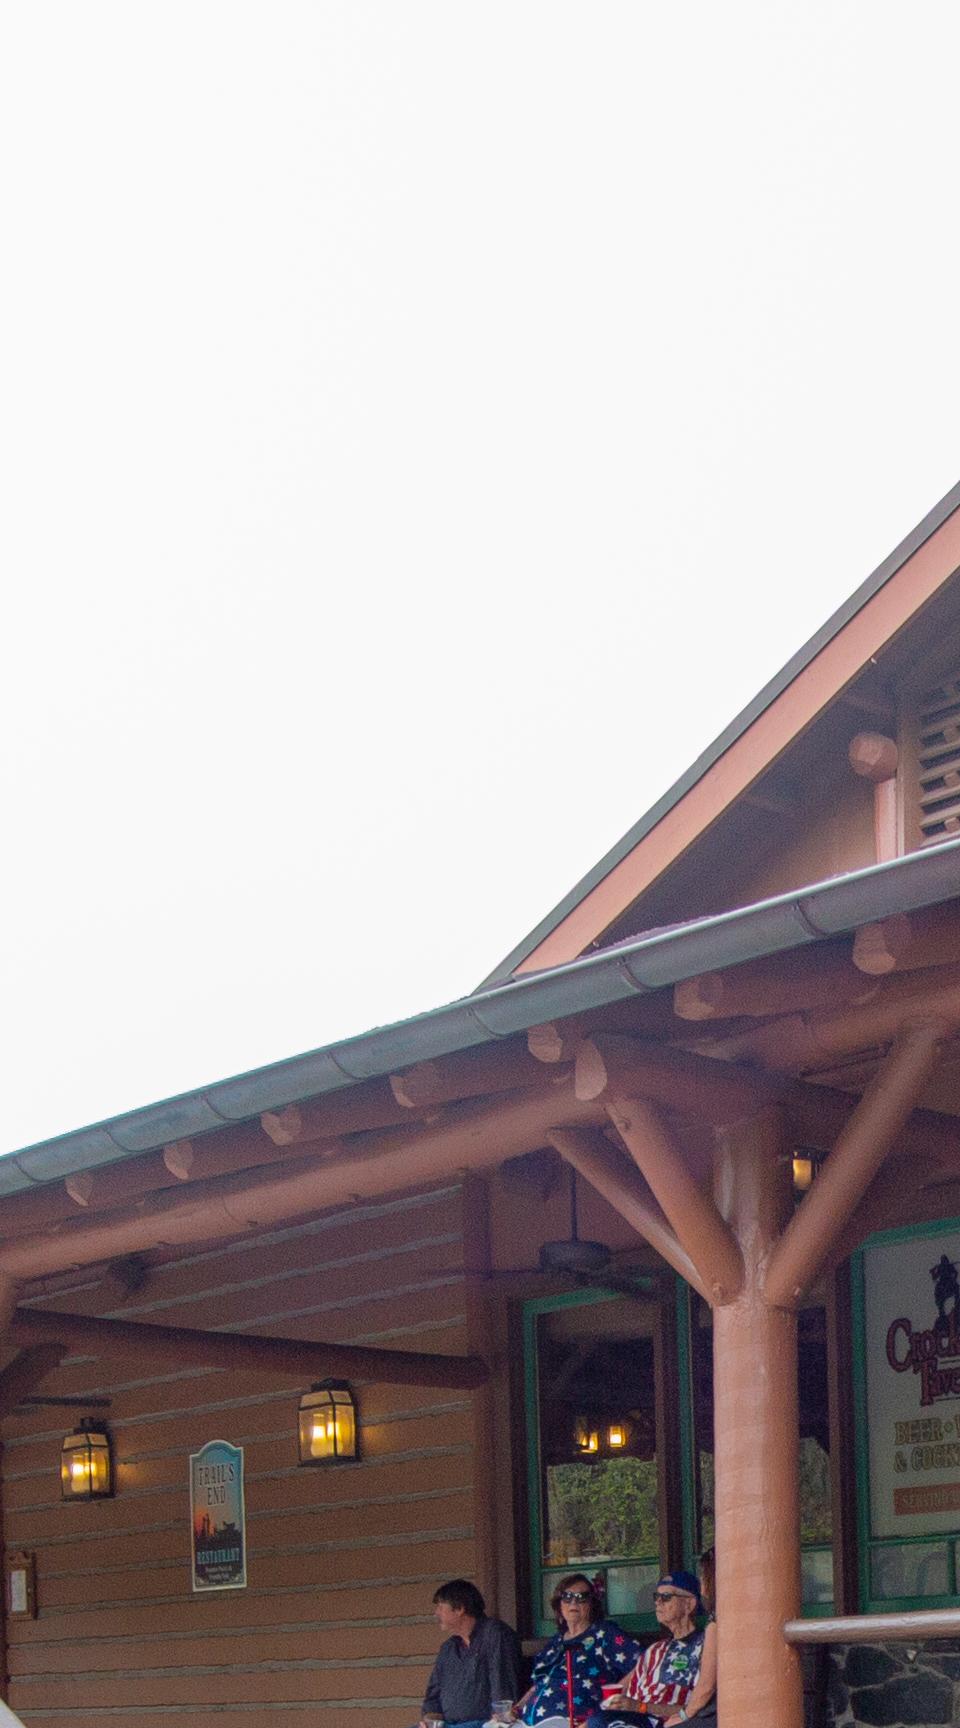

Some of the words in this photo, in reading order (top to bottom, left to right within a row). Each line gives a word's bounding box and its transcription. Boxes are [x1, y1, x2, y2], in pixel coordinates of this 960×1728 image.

[894, 1417, 943, 1445] BEER
[894, 1450, 907, 1473] &
[198, 1463, 235, 1486] TRAIL'S
[207, 1485, 226, 1506] END
